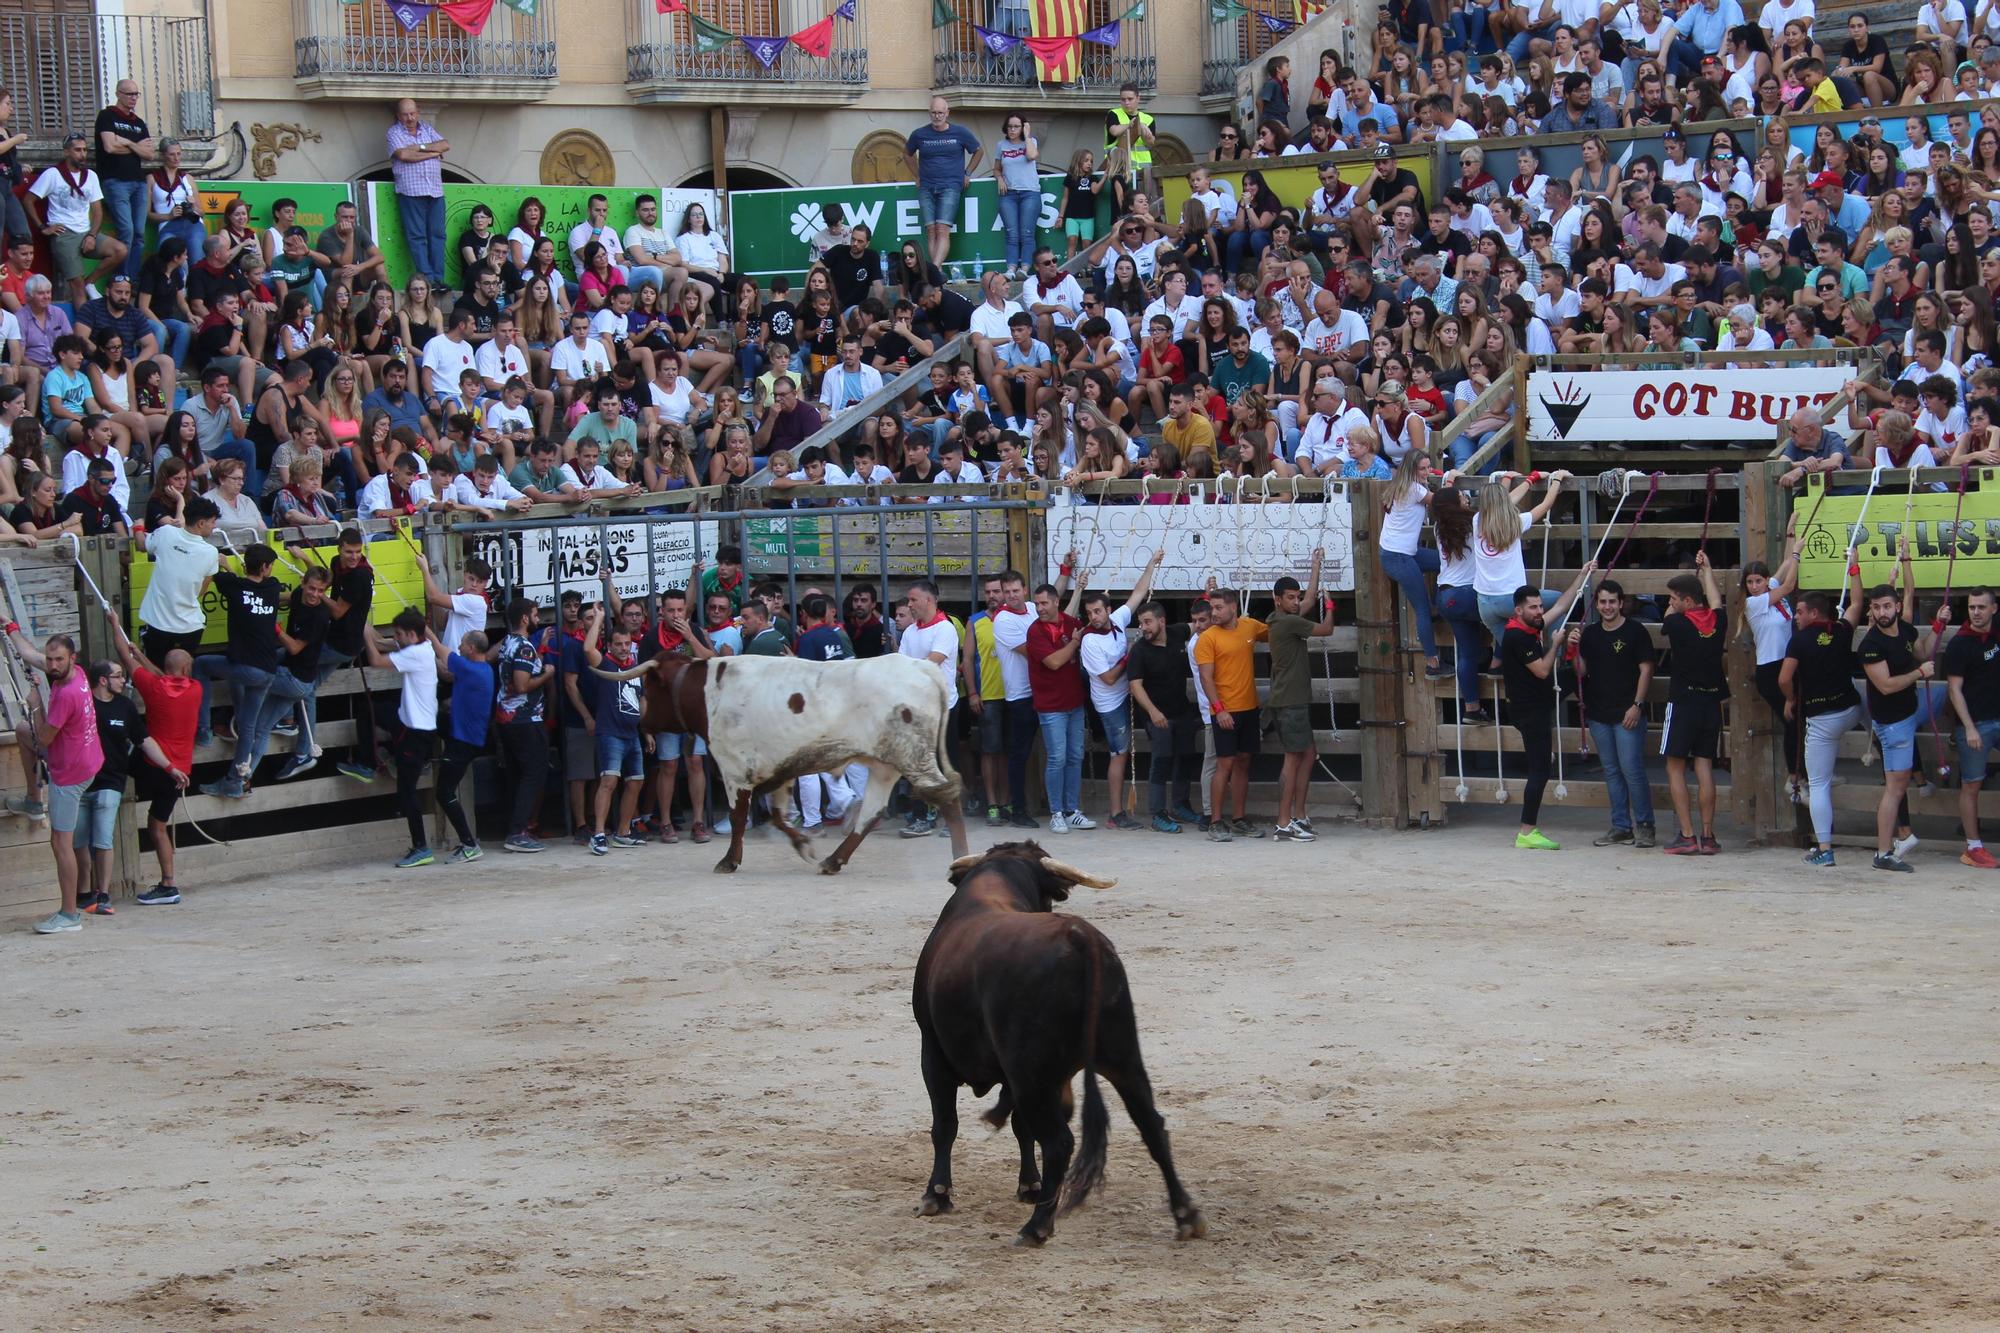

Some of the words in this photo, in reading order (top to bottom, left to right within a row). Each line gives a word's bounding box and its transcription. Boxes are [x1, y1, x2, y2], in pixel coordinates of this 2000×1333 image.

[562, 203, 580, 215] LA
[841, 193, 1059, 236] WEIS
[1633, 382, 1718, 420] GOT
